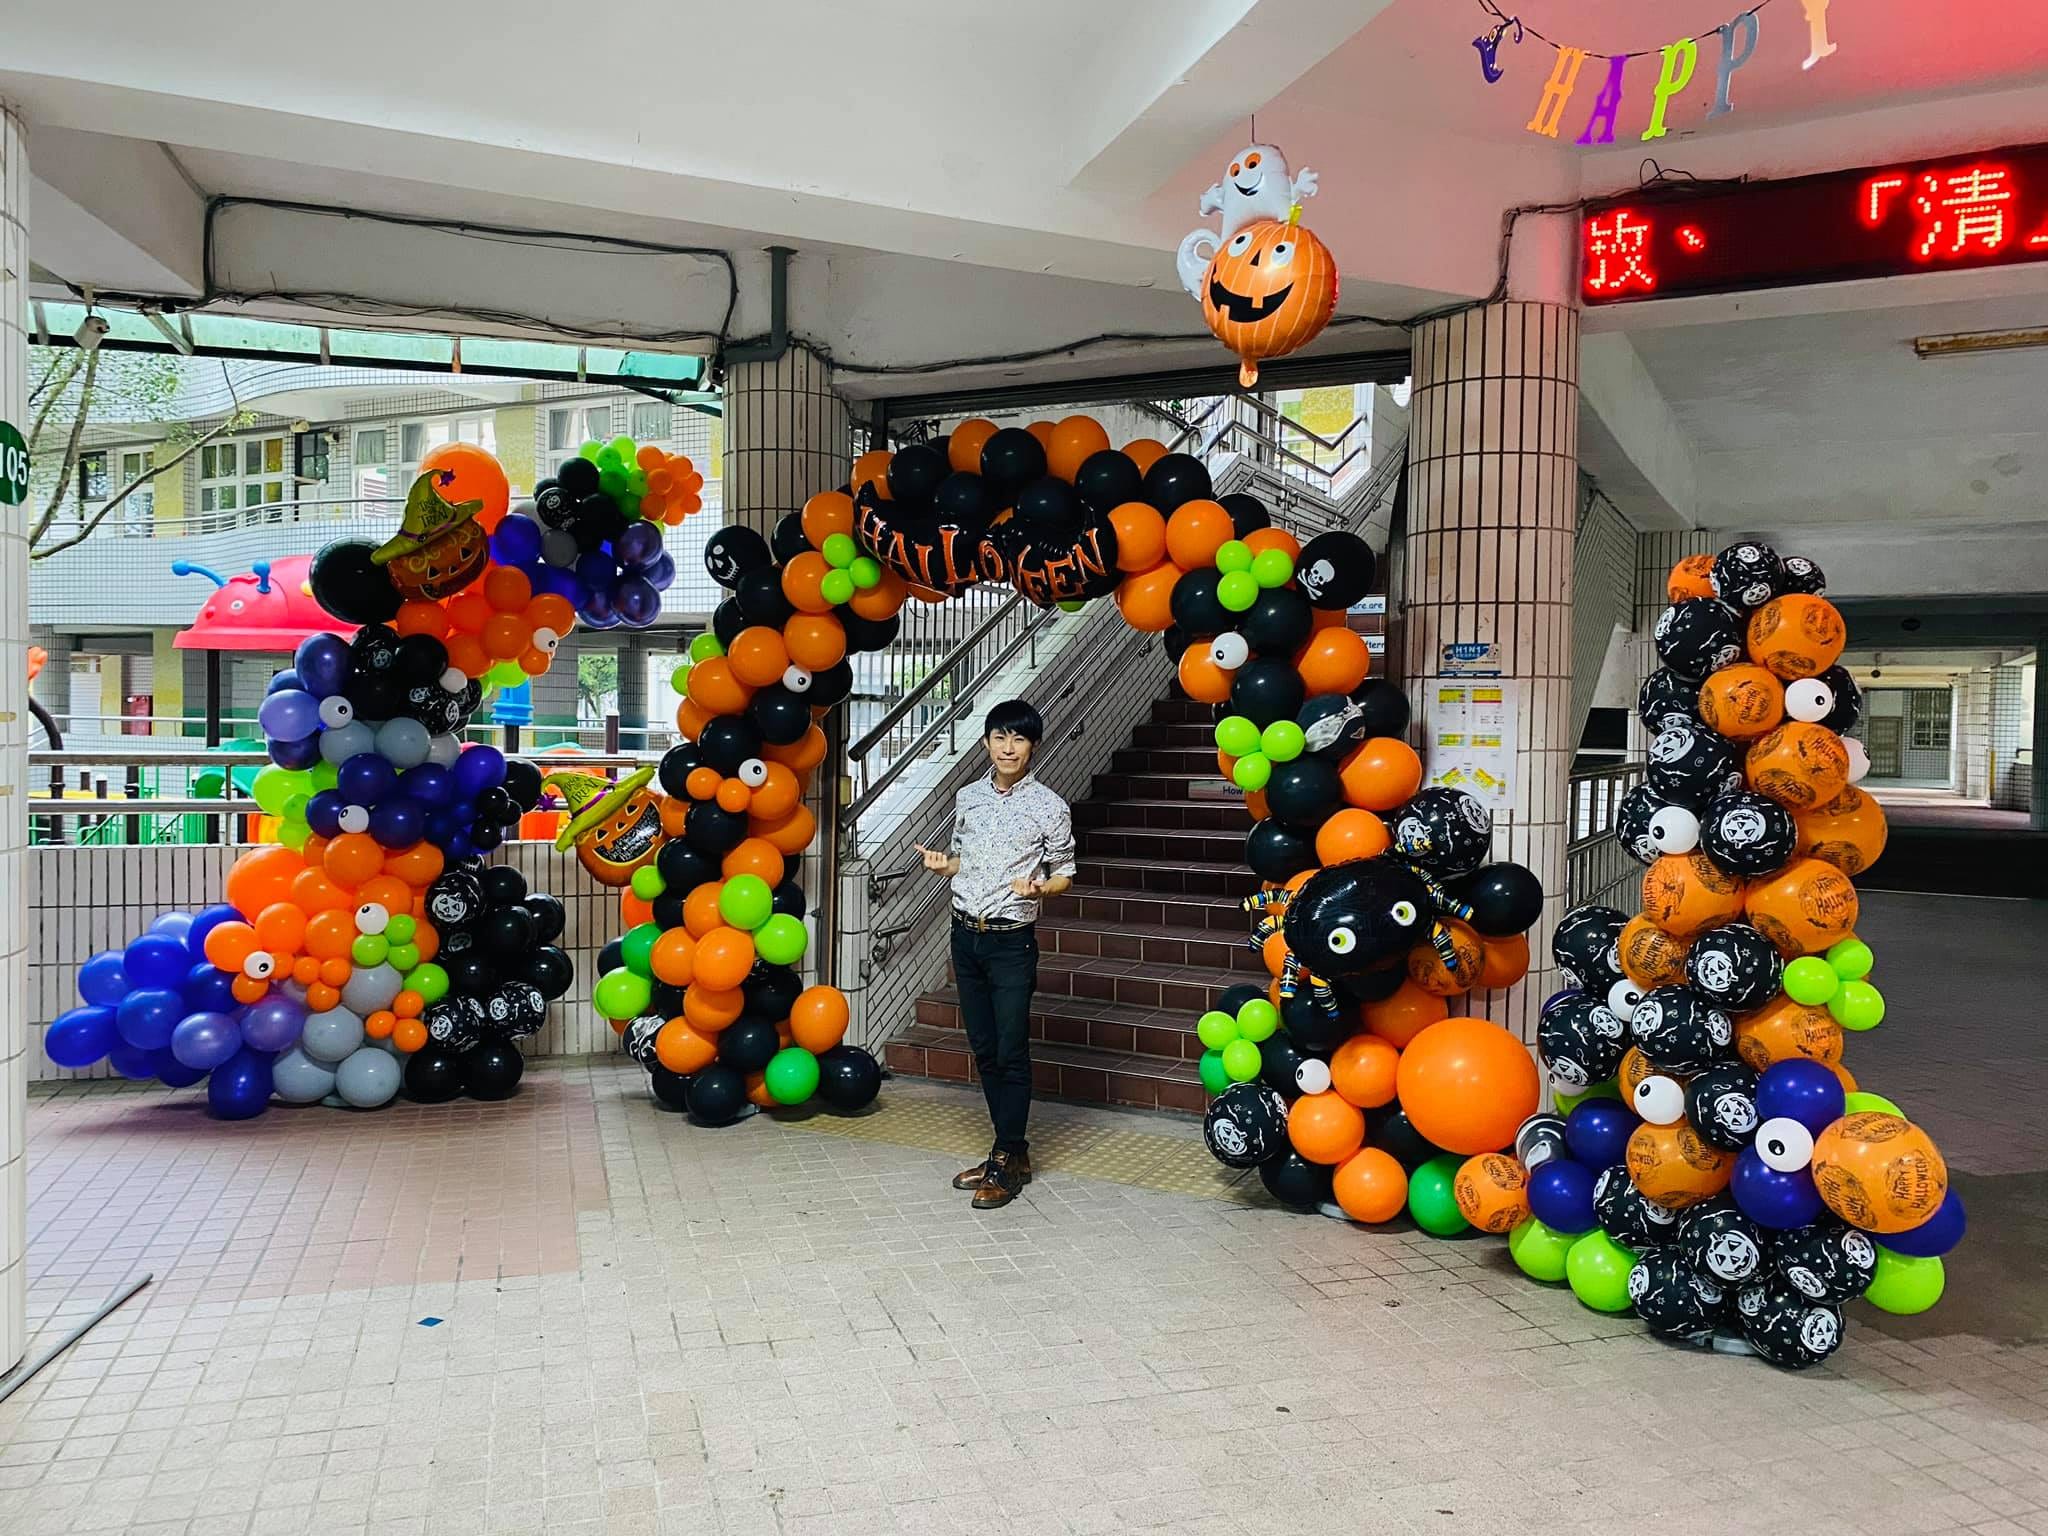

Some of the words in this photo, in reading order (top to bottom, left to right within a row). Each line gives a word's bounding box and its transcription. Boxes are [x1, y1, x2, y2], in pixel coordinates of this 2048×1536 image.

[1222, 785, 1244, 796] How
[1895, 1169, 1912, 1200] HAPPY
[1911, 1158, 1929, 1209] HALLOWEEN
